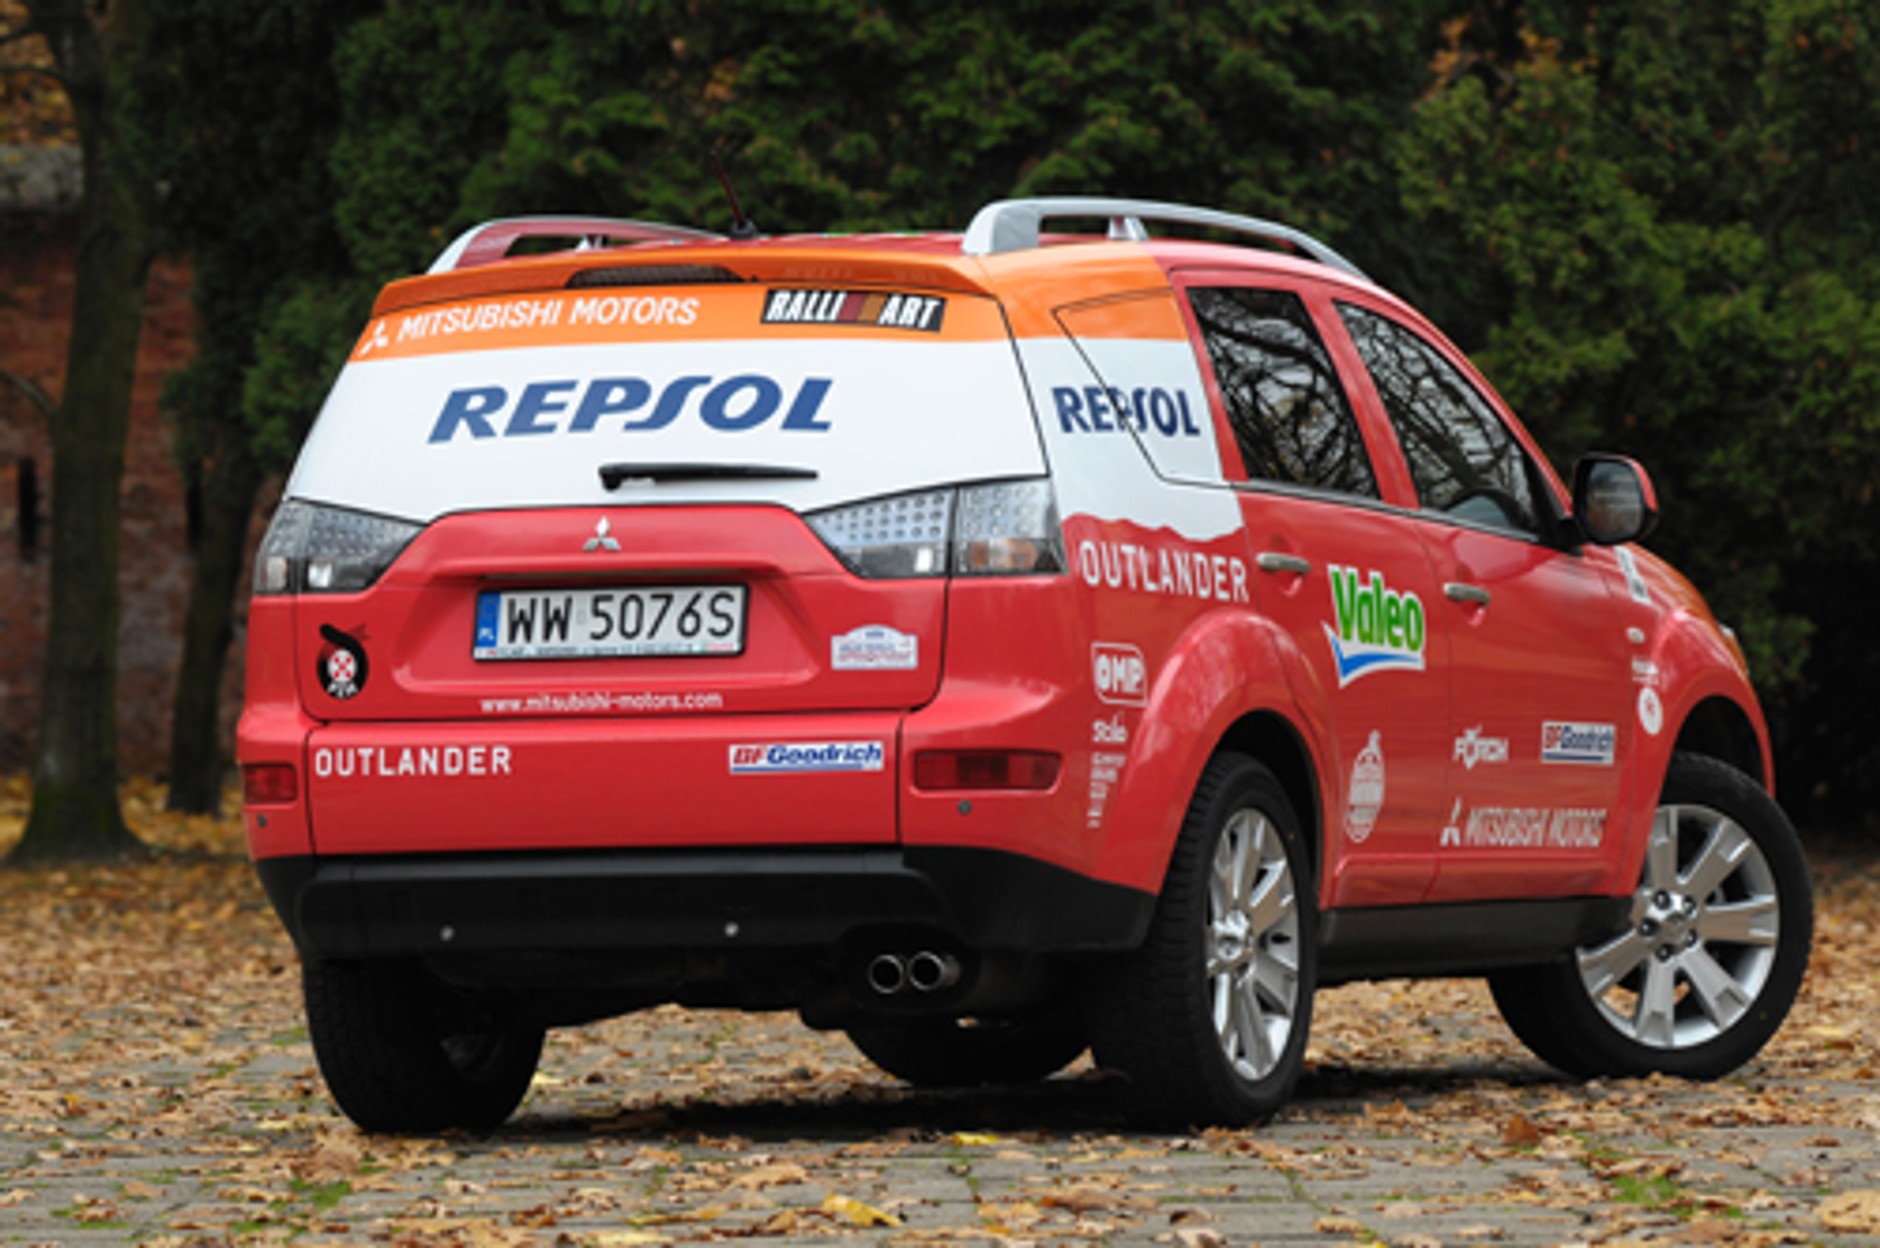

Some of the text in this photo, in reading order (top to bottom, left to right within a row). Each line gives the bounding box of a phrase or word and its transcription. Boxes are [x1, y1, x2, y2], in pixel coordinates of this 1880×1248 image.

[396, 297, 699, 343] MITSUBISHI MOTORS
[428, 374, 834, 444] REPSOL
[1052, 385, 1200, 437] REPSOL
[1080, 539, 1250, 604] OUTLANDER
[505, 590, 736, 645] WW 5076S
[1332, 570, 1424, 652] Valeo
[480, 690, 724, 713] www.mitsubishi-motors.com
[314, 746, 513, 778] OUTLANDER
[733, 743, 882, 766] BFGoodrich
